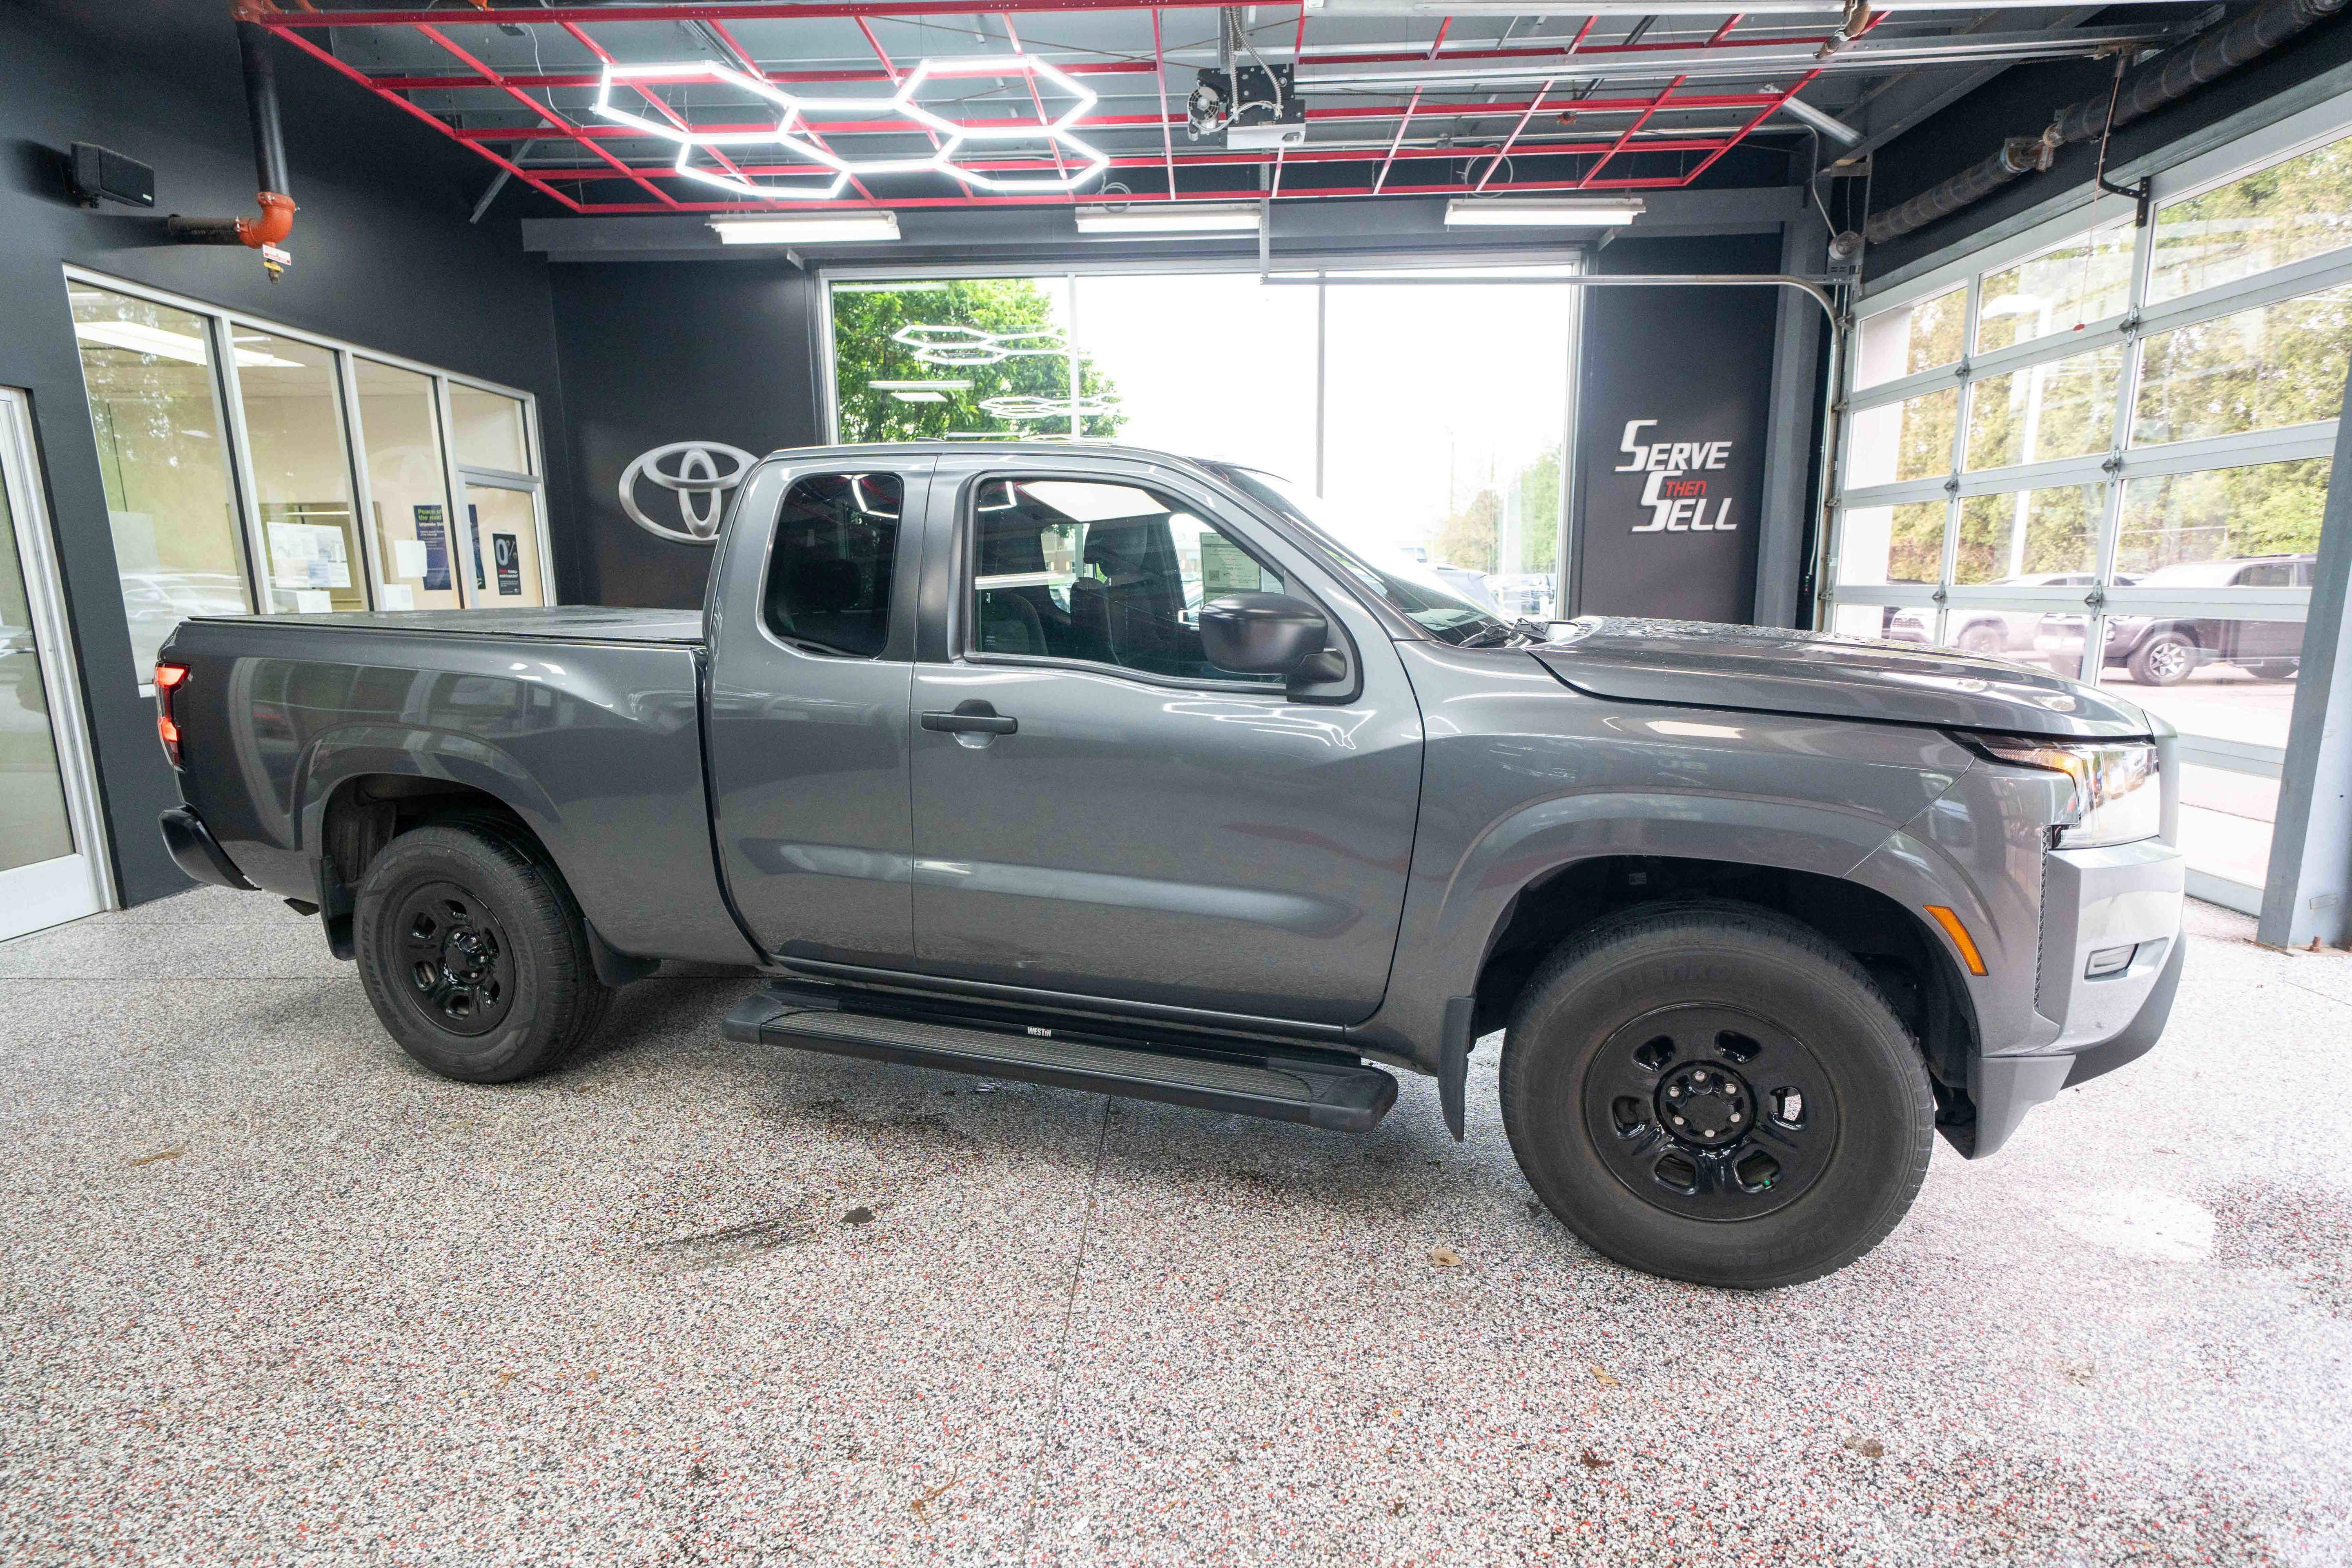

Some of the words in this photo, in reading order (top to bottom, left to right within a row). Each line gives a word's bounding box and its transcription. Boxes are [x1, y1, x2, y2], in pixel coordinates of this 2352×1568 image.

[1614, 419, 1732, 472] SERVE
[1631, 470, 1737, 532] SELL
[1666, 480, 1706, 497] THEN
